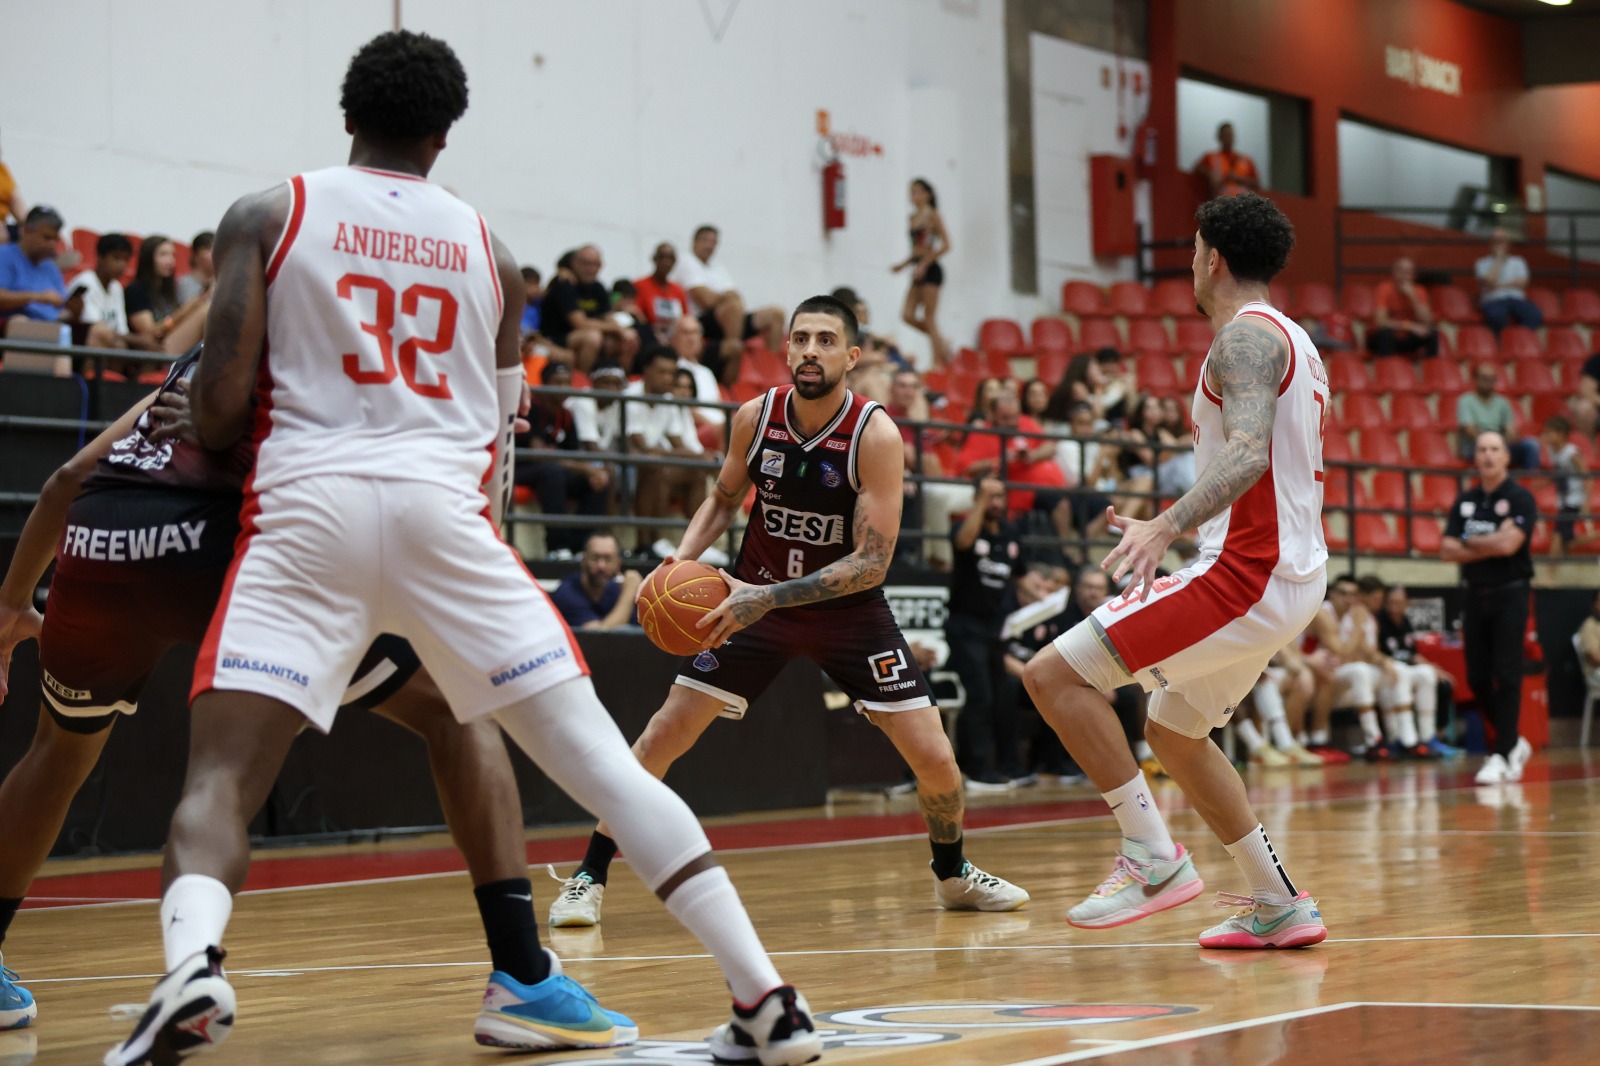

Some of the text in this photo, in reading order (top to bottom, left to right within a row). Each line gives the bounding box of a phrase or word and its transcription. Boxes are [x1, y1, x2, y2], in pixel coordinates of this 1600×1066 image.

[333, 222, 467, 273] ANDERSON
[337, 273, 459, 400] 32
[770, 430, 787, 439] SESI
[63, 520, 206, 561] FREEWAY
[765, 509, 834, 543] SESI
[787, 548, 804, 578] 6
[222, 657, 309, 686] BRASANITAS
[878, 679, 917, 692] FREEWAY
